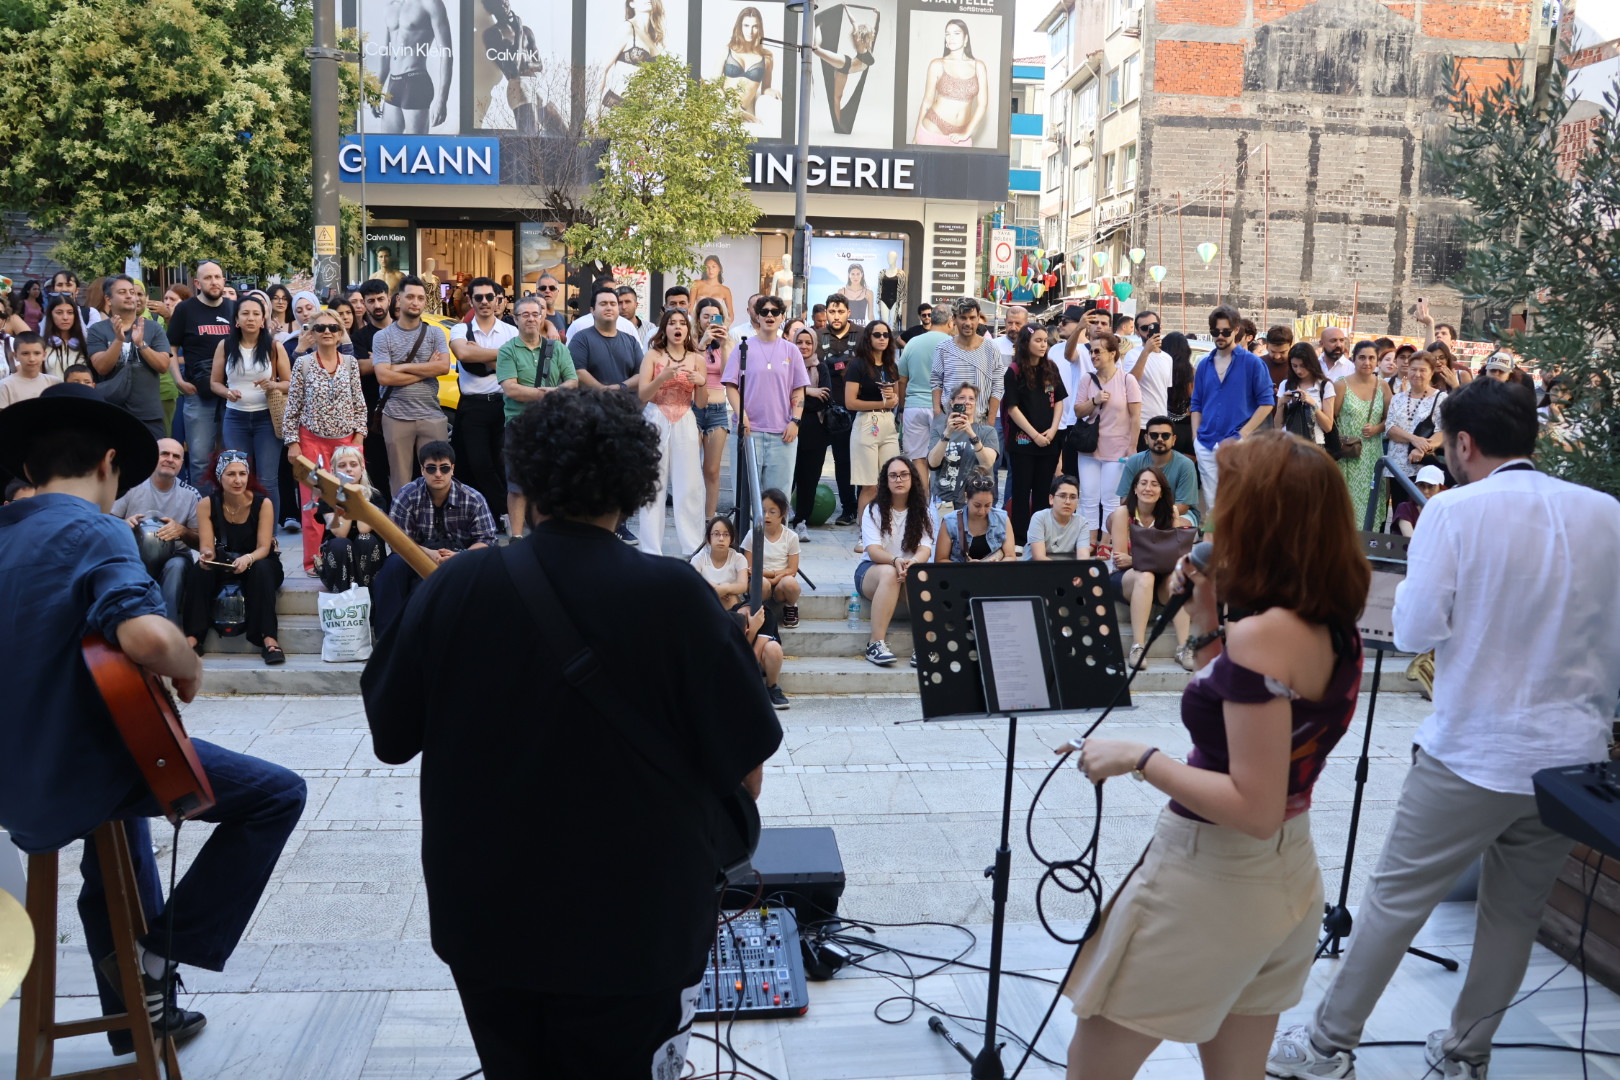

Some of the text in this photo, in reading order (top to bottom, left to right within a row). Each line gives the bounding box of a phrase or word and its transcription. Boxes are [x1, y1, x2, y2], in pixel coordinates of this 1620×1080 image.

[958, 6, 994, 14] SoftStretch
[365, 41, 452, 58] Calvin Klein
[485, 47, 528, 62] Calvin
[379, 144, 492, 176] MANN
[741, 151, 916, 191] INGERIE
[366, 233, 406, 242] Calvin Klein
[322, 603, 369, 622] NOST
[325, 619, 364, 628] VINTAGE
